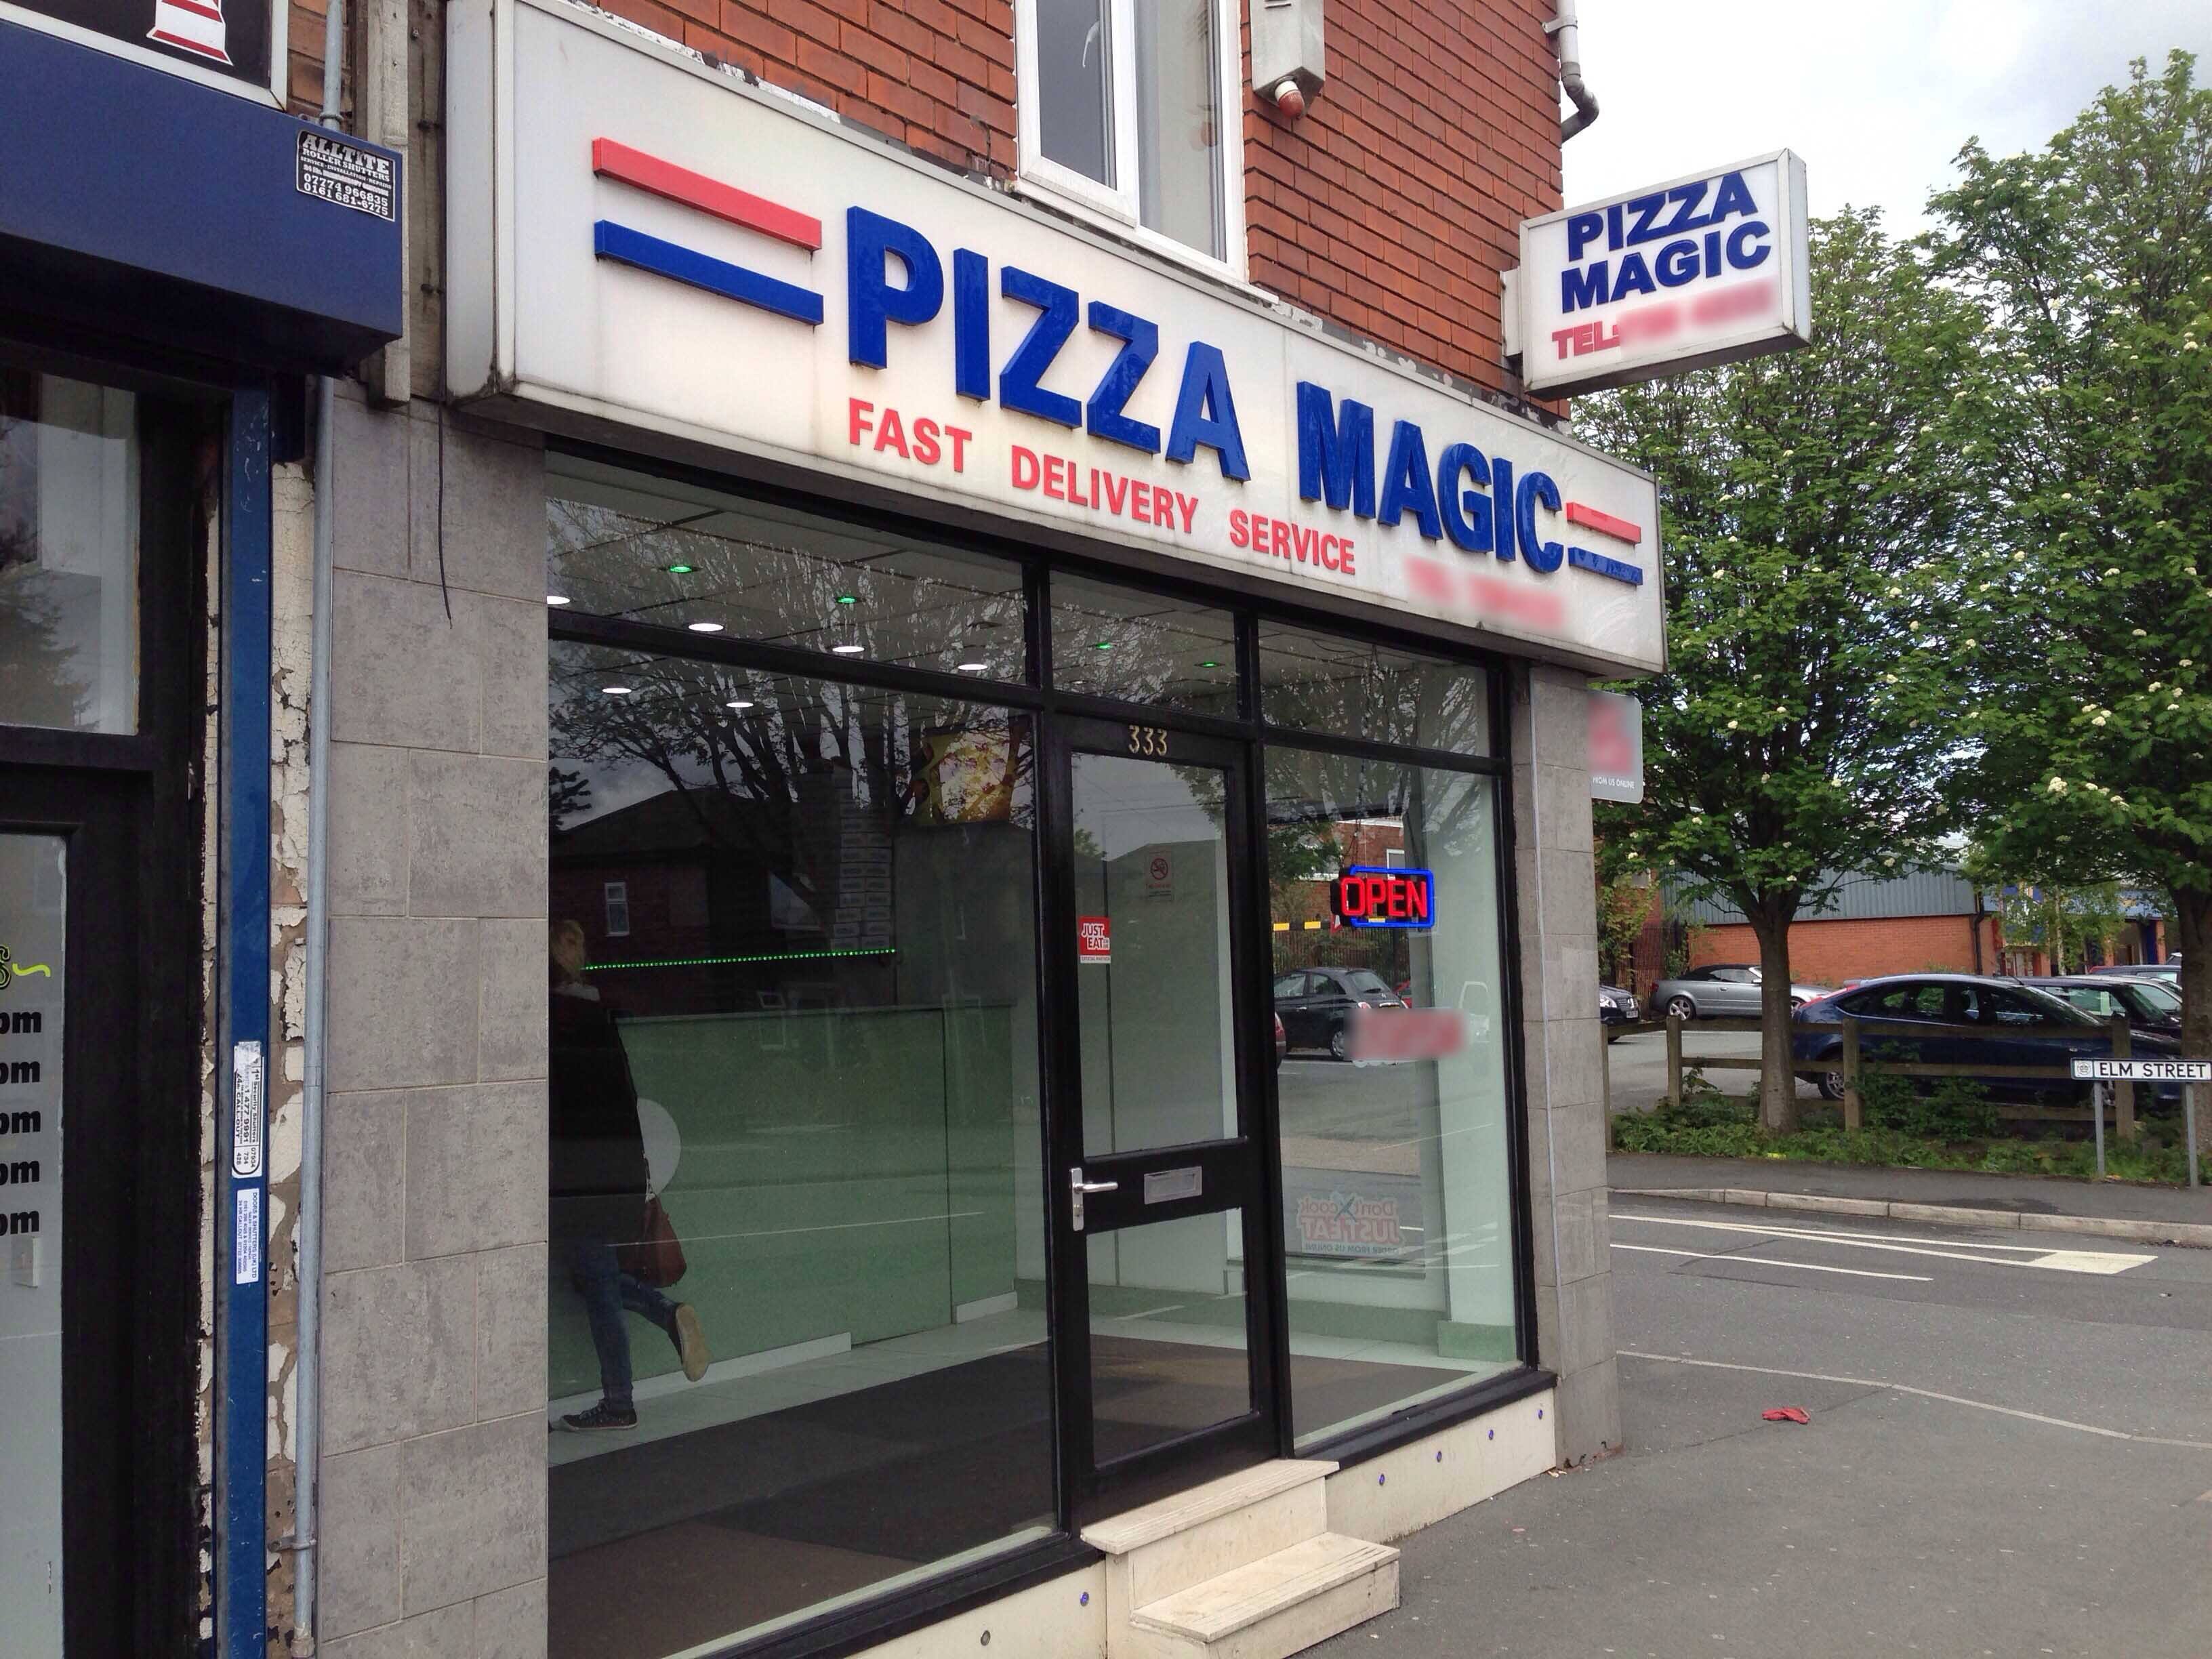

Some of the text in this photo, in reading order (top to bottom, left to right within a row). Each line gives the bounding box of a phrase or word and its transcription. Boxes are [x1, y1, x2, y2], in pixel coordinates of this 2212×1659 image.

[300, 157, 324, 167] SERVICE
[303, 134, 389, 175] ALLTITE
[303, 148, 341, 167] ROLLER
[342, 161, 390, 182] SHUTTERS
[304, 173, 342, 192] 07774
[344, 185, 388, 207] 966835
[304, 183, 332, 199] 0161
[1567, 171, 1759, 262] PIZZA
[1561, 220, 1771, 314] MAGIC
[847, 205, 1564, 573] PIZZA MAGIC
[849, 398, 1355, 575] FAST DELIVERY SERVICE
[1128, 724, 1167, 756] 333
[1340, 877, 1428, 918] OPEN
[1082, 924, 1104, 937] JUST
[1088, 937, 1104, 949] EAT
[2100, 1062, 2207, 1079] ELM STREET
